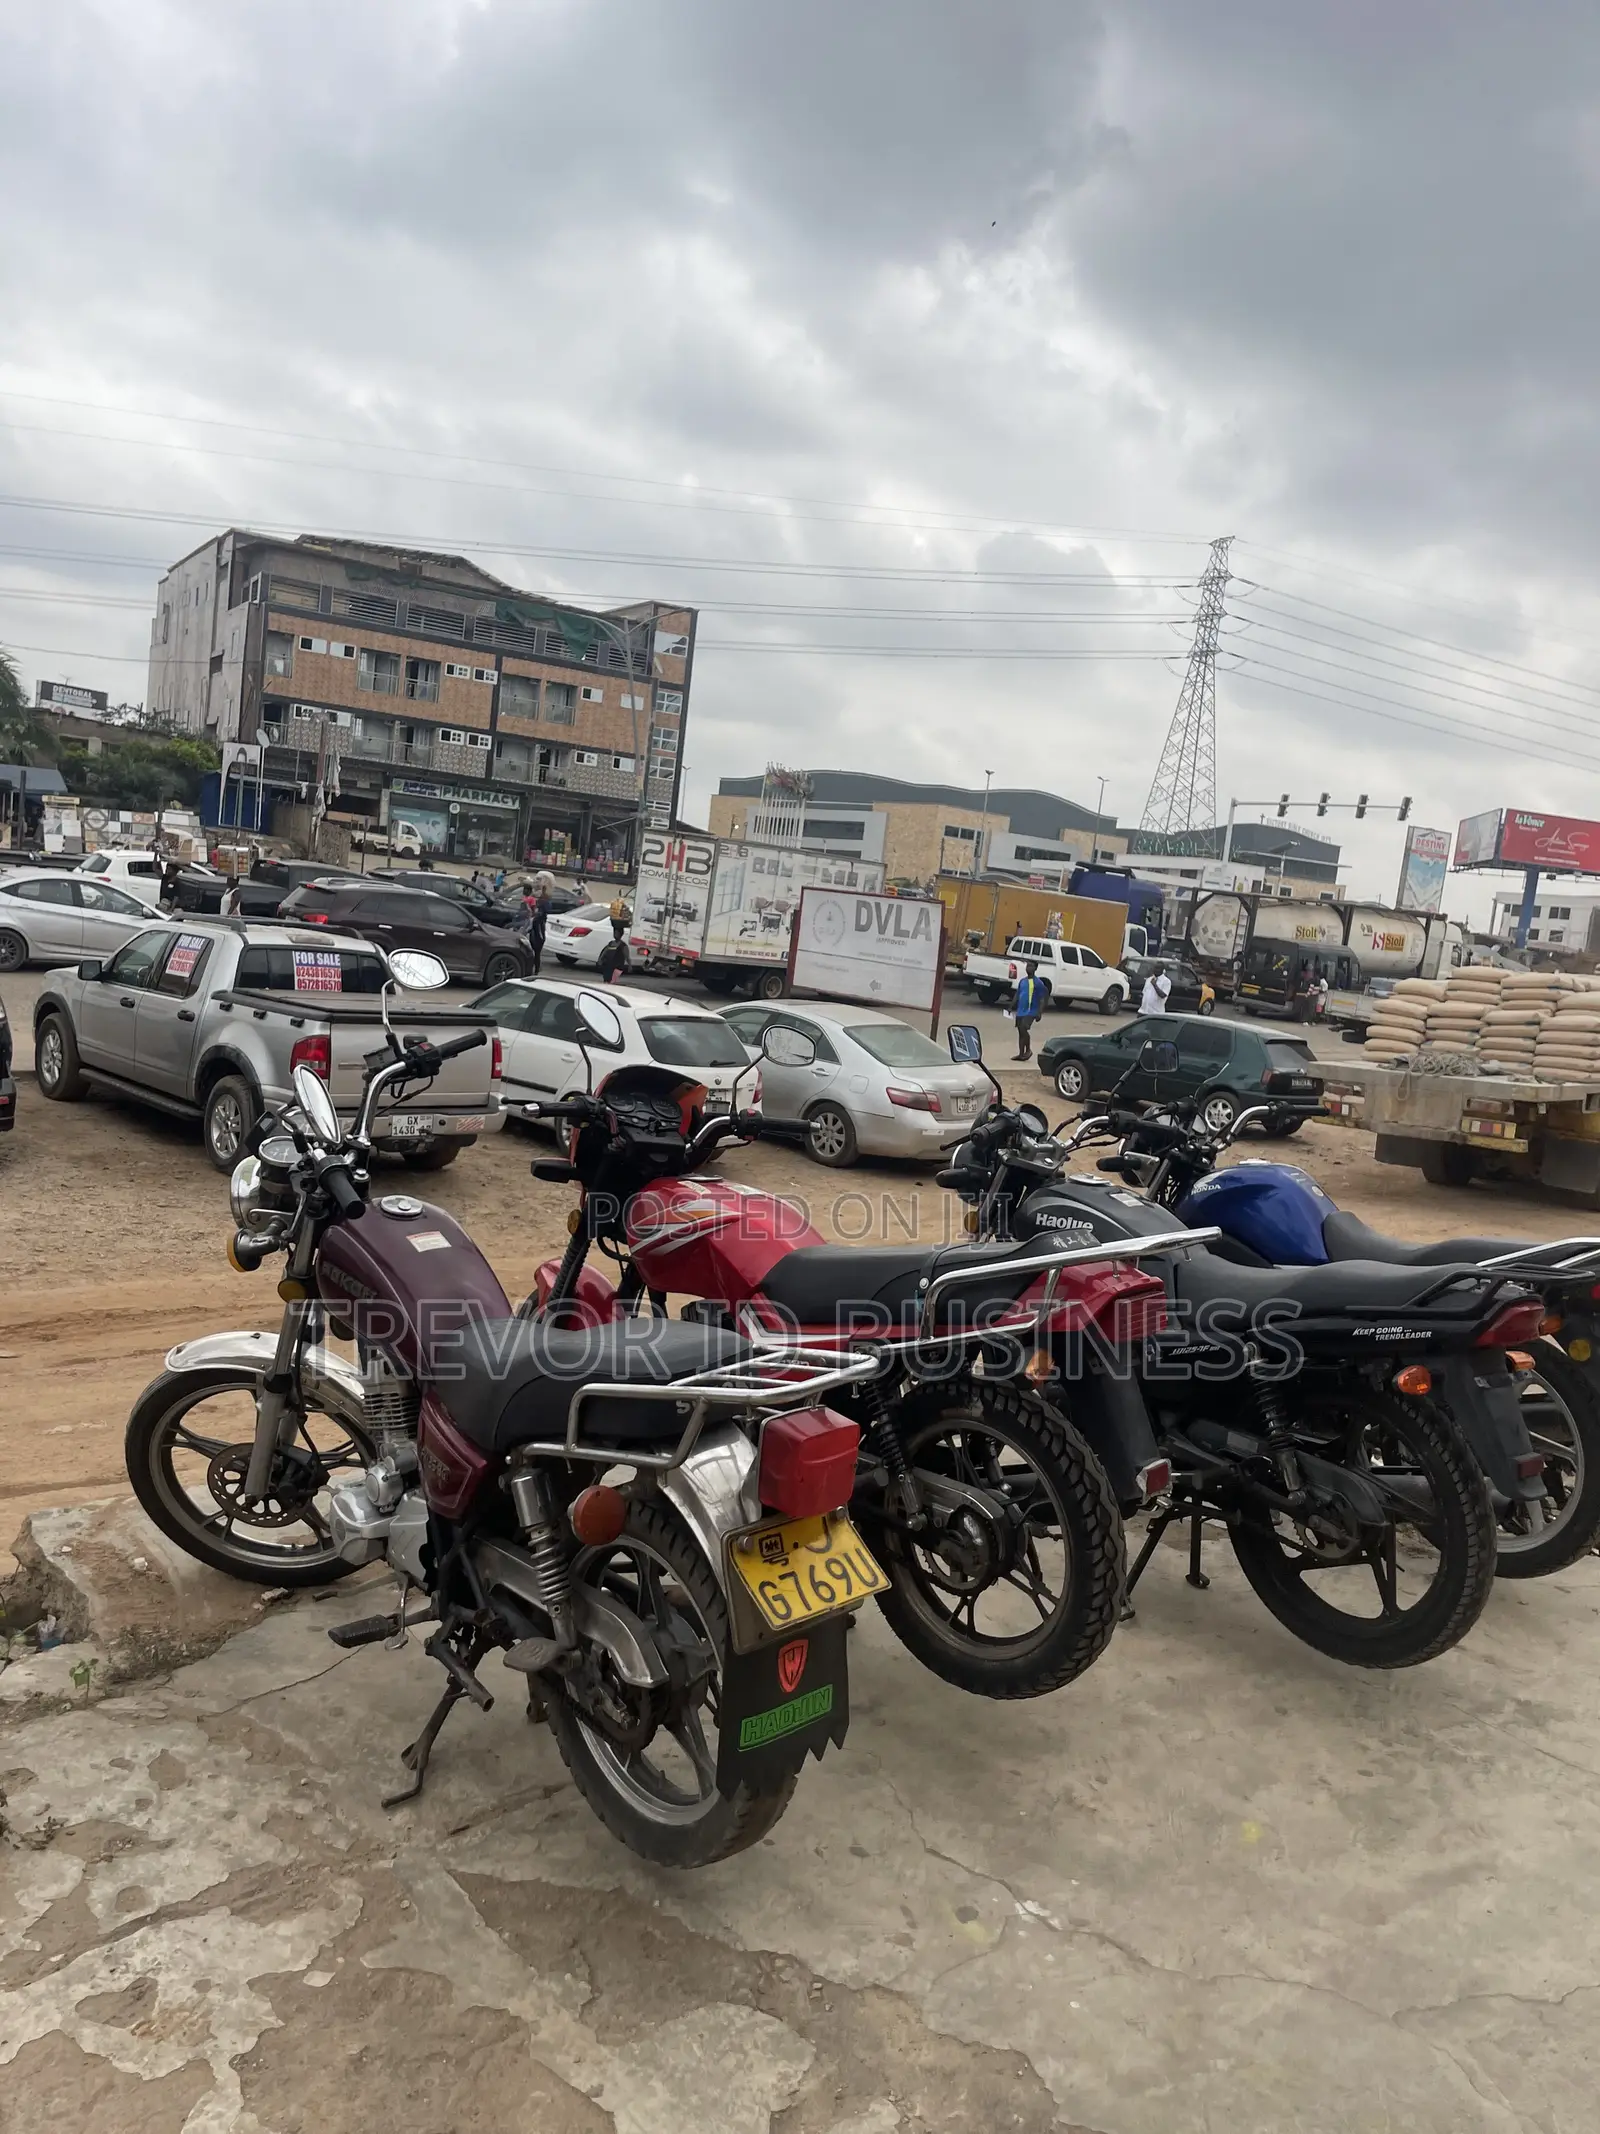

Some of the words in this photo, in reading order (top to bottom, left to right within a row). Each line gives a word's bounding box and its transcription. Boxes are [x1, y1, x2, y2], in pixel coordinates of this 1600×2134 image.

[442, 785, 518, 806] PHARMACY
[1416, 838, 1445, 850] DESTINY
[854, 899, 933, 942] DVLA
[1295, 924, 1317, 939] Stolt
[179, 934, 190, 947] FOR
[189, 936, 205, 949] SALE
[1386, 935, 1404, 947] Stolt
[295, 951, 314, 964] FOR
[317, 953, 341, 966] SALE
[407, 1115, 419, 1126] GX
[1191, 1184, 1221, 1195] HONDA
[1035, 1212, 1094, 1232] Haojue
[1352, 1327, 1375, 1336] KEEP
[1375, 1331, 1432, 1341] TRENDLEADER
[758, 1547, 879, 1620] G769U
